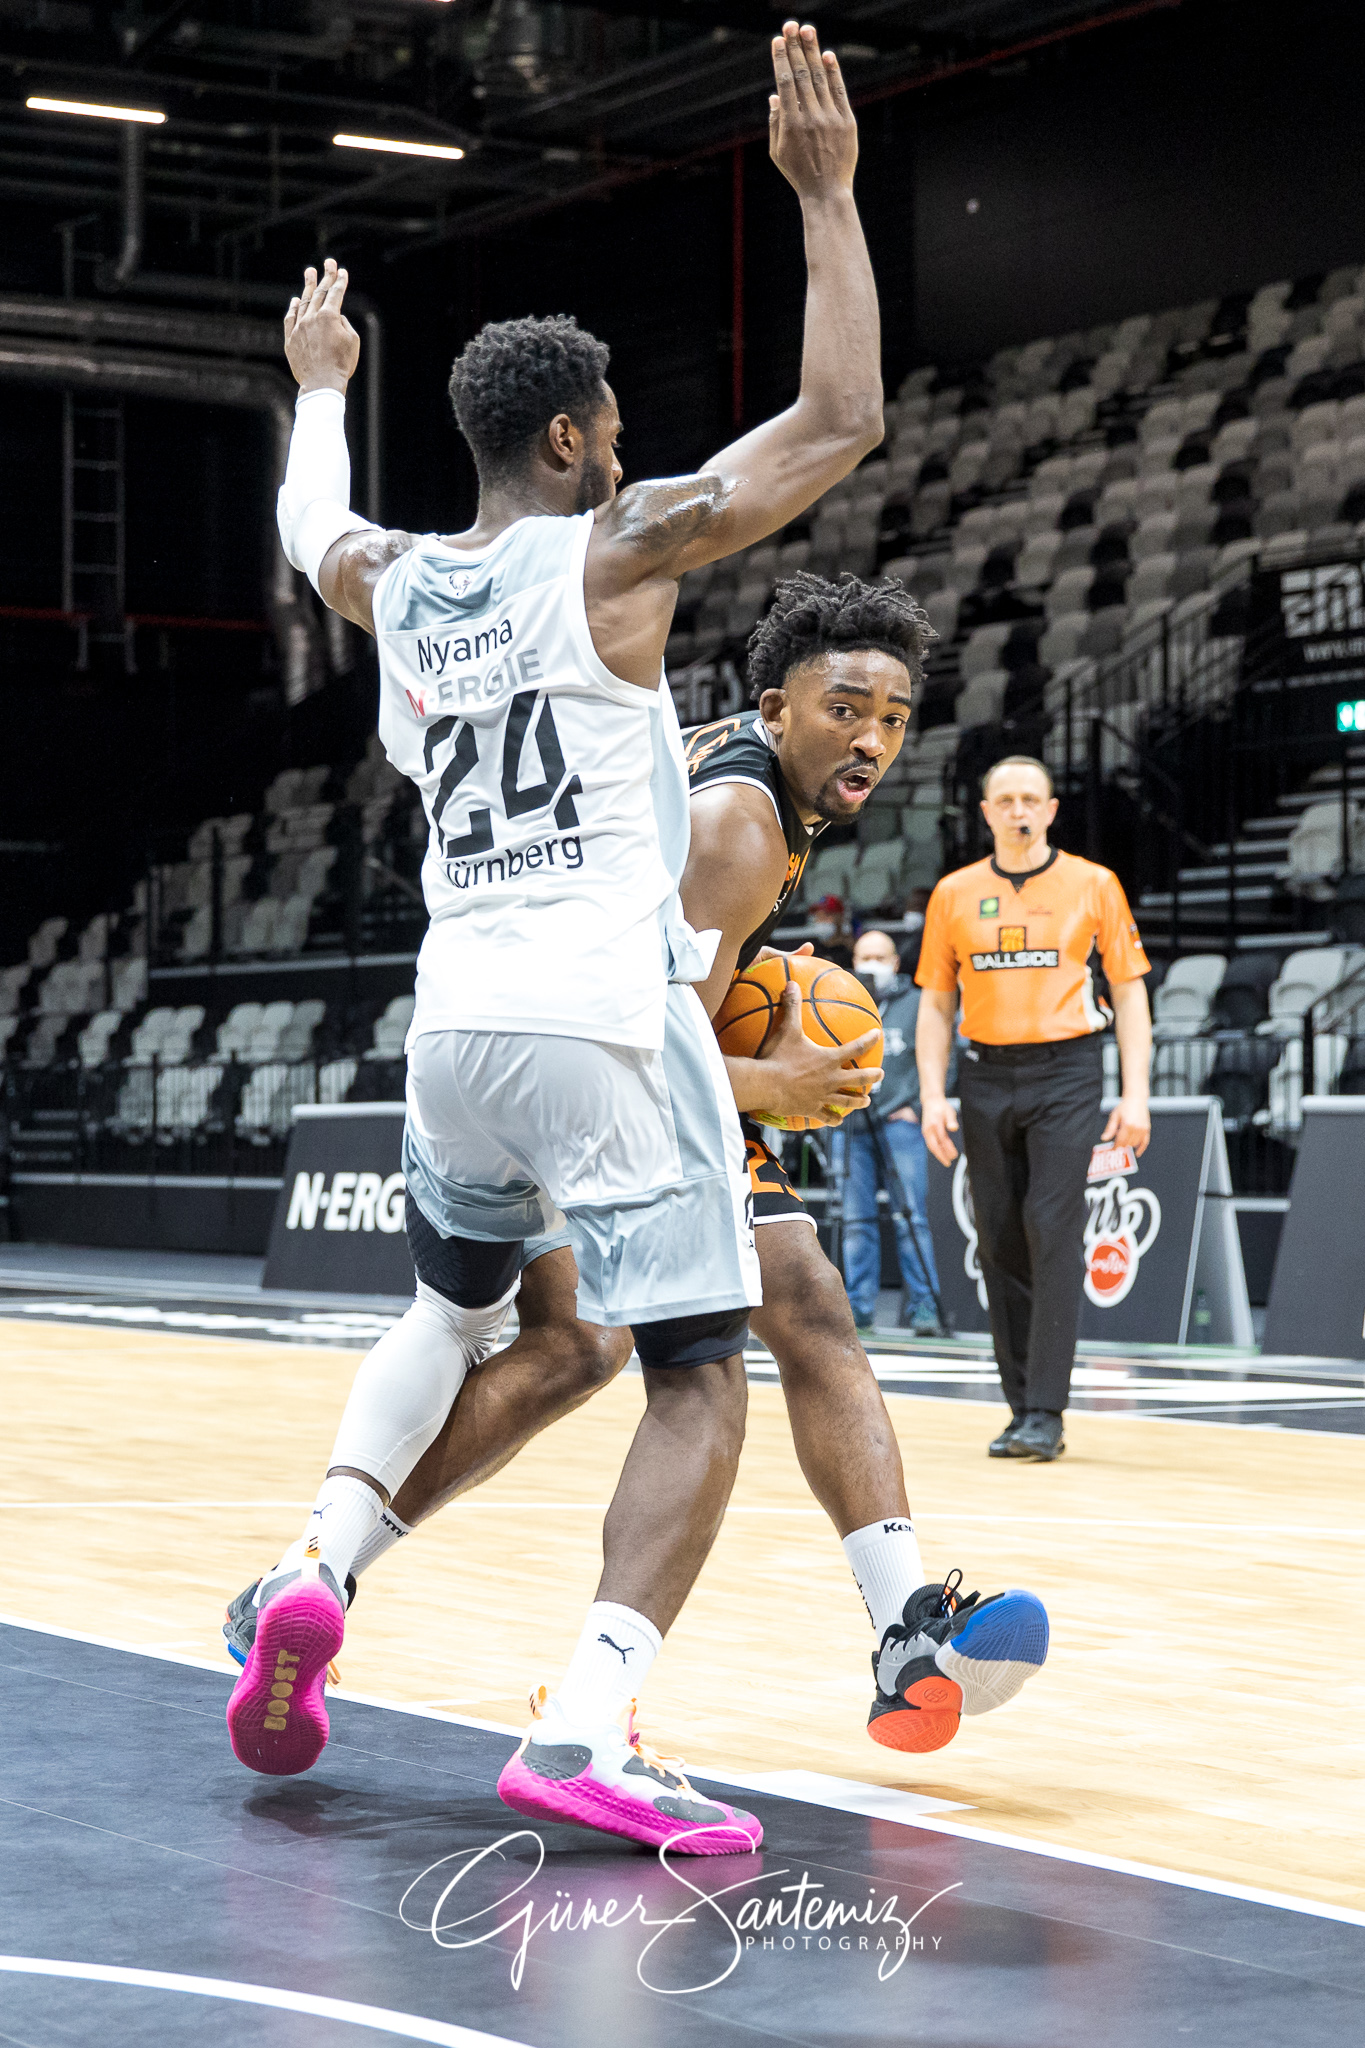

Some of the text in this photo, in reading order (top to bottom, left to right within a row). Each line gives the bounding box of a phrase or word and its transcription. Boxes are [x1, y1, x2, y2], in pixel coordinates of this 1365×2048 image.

[417, 618, 513, 676] Nyama
[422, 689, 584, 859] 24
[972, 951, 1058, 971] BALLSIDE
[285, 1171, 407, 1233] N-ERG
[263, 1649, 300, 1731] BOOST
